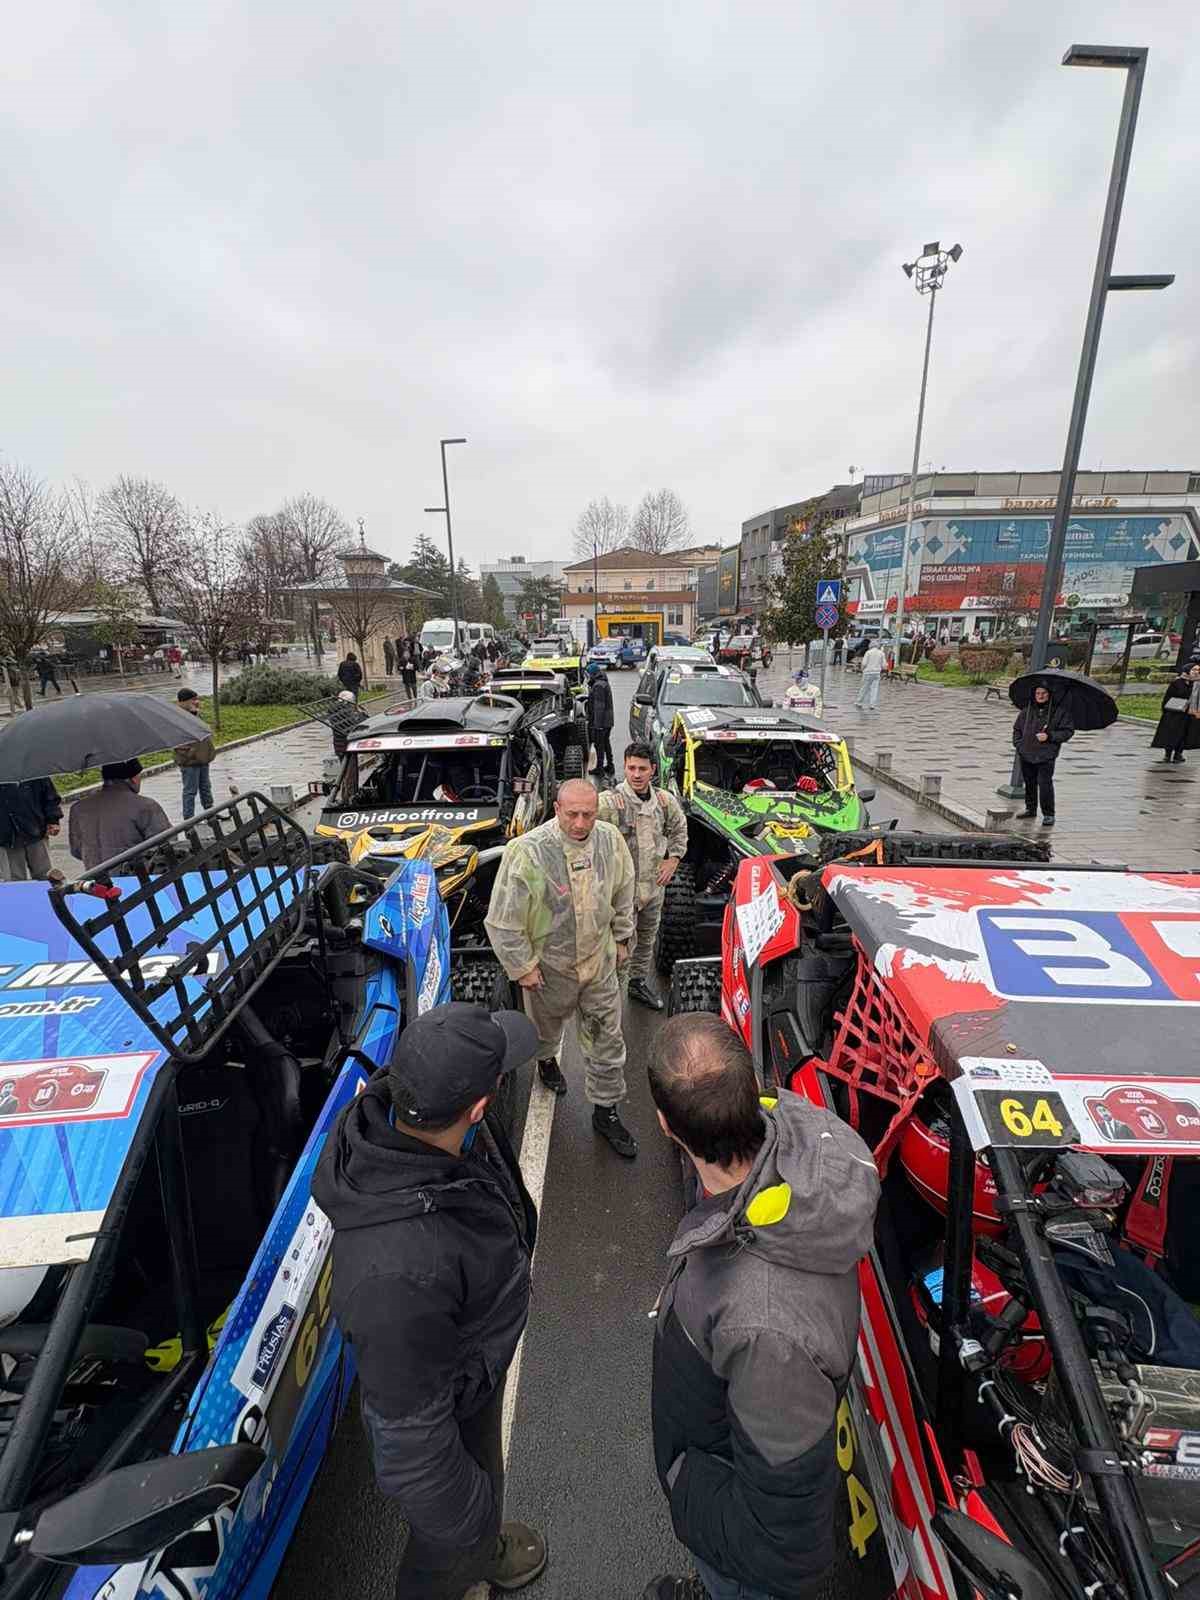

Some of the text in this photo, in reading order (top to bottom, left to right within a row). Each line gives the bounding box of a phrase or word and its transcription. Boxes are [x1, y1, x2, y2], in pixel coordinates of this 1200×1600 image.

[359, 809, 478, 825] hidrooffroad
[999, 1098, 1064, 1137] 64
[836, 1395, 879, 1559] 64
